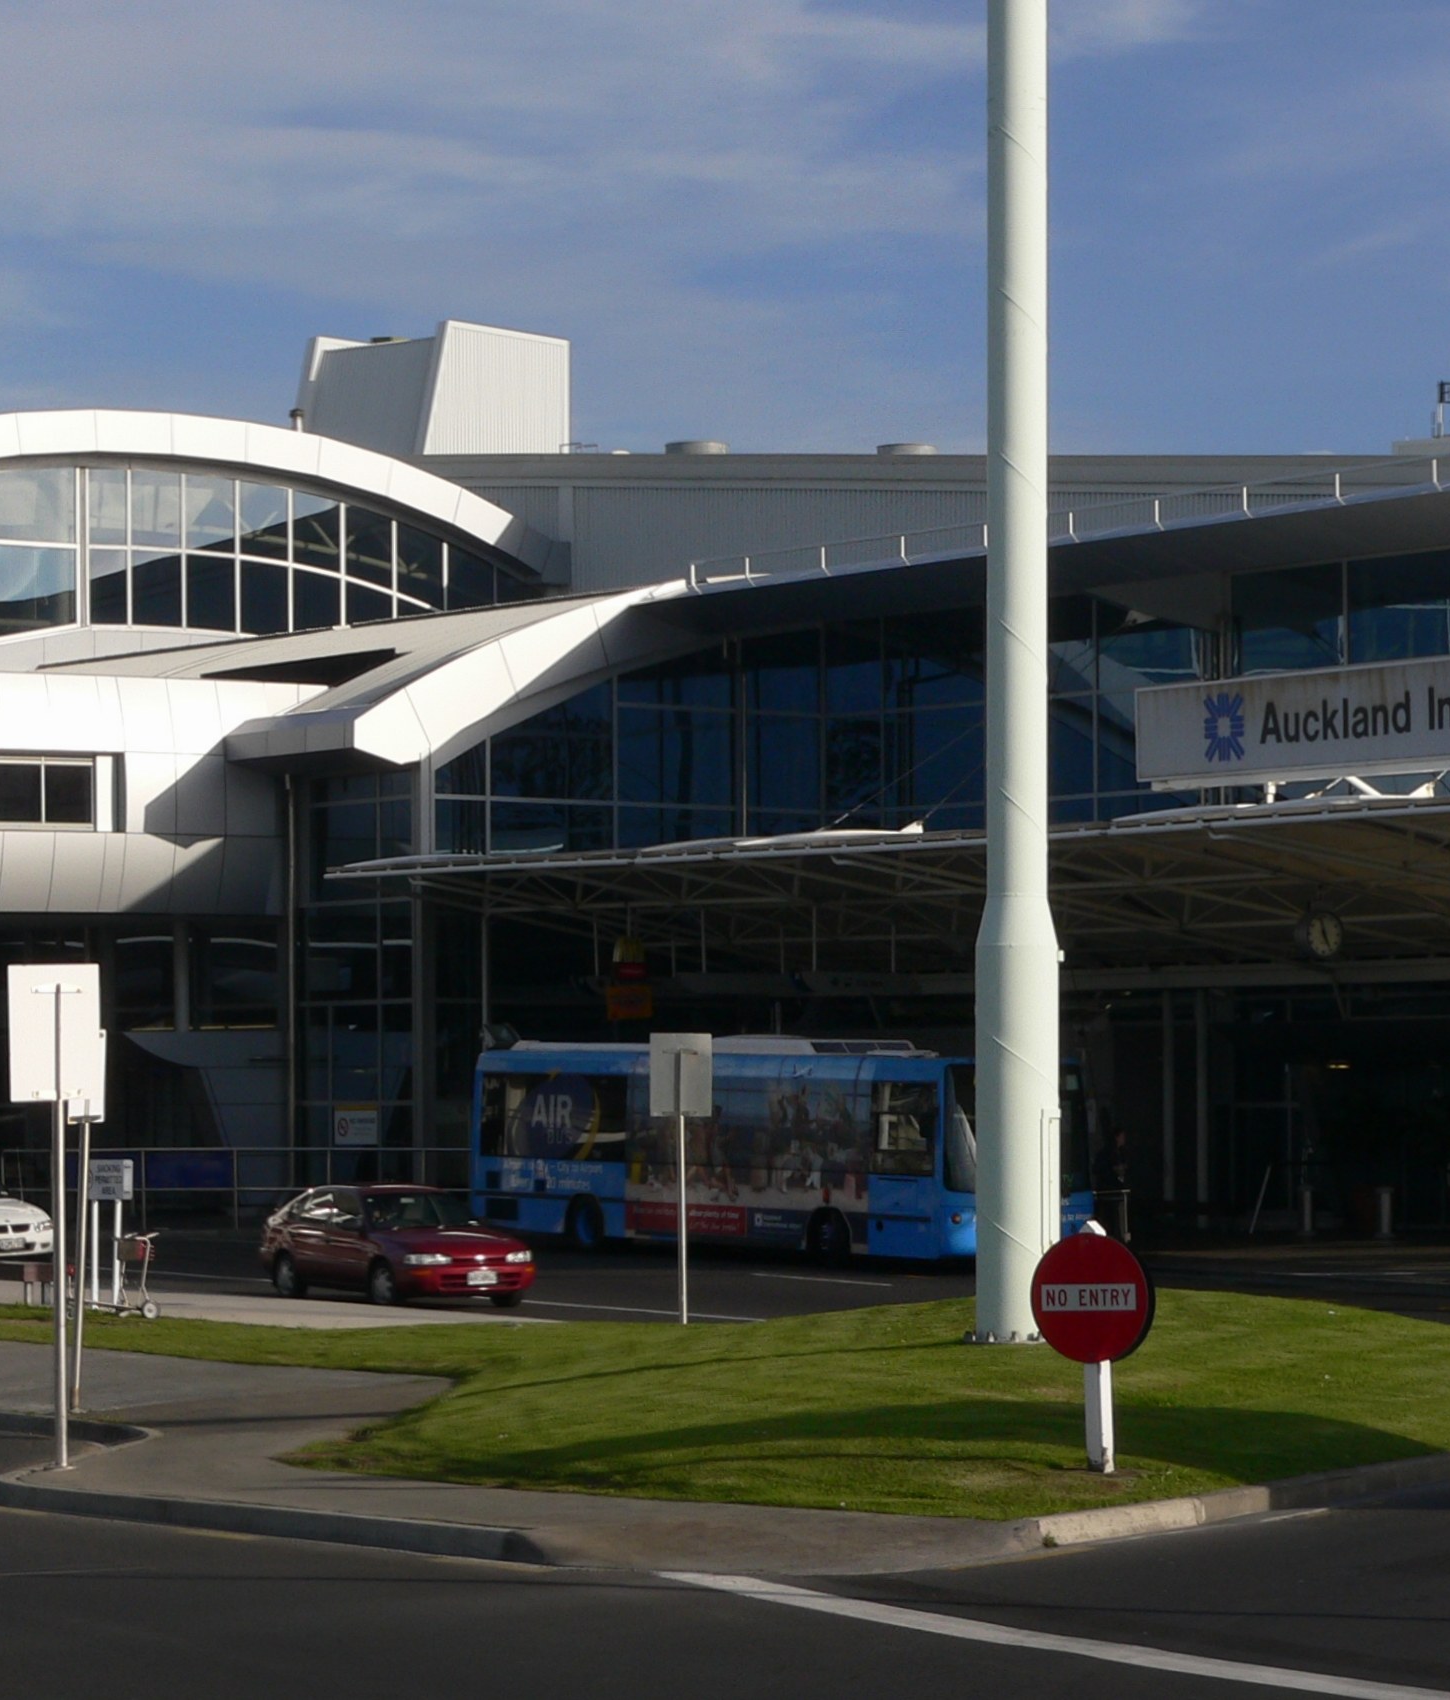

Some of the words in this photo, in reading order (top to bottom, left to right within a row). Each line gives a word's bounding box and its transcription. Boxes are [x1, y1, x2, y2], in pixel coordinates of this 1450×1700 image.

[1260, 689, 1411, 744] Auckland
[531, 1093, 573, 1128] AIR
[547, 1129, 573, 1145] BUS
[1046, 1288, 1068, 1307] NO
[1078, 1288, 1131, 1307] ENTRY
